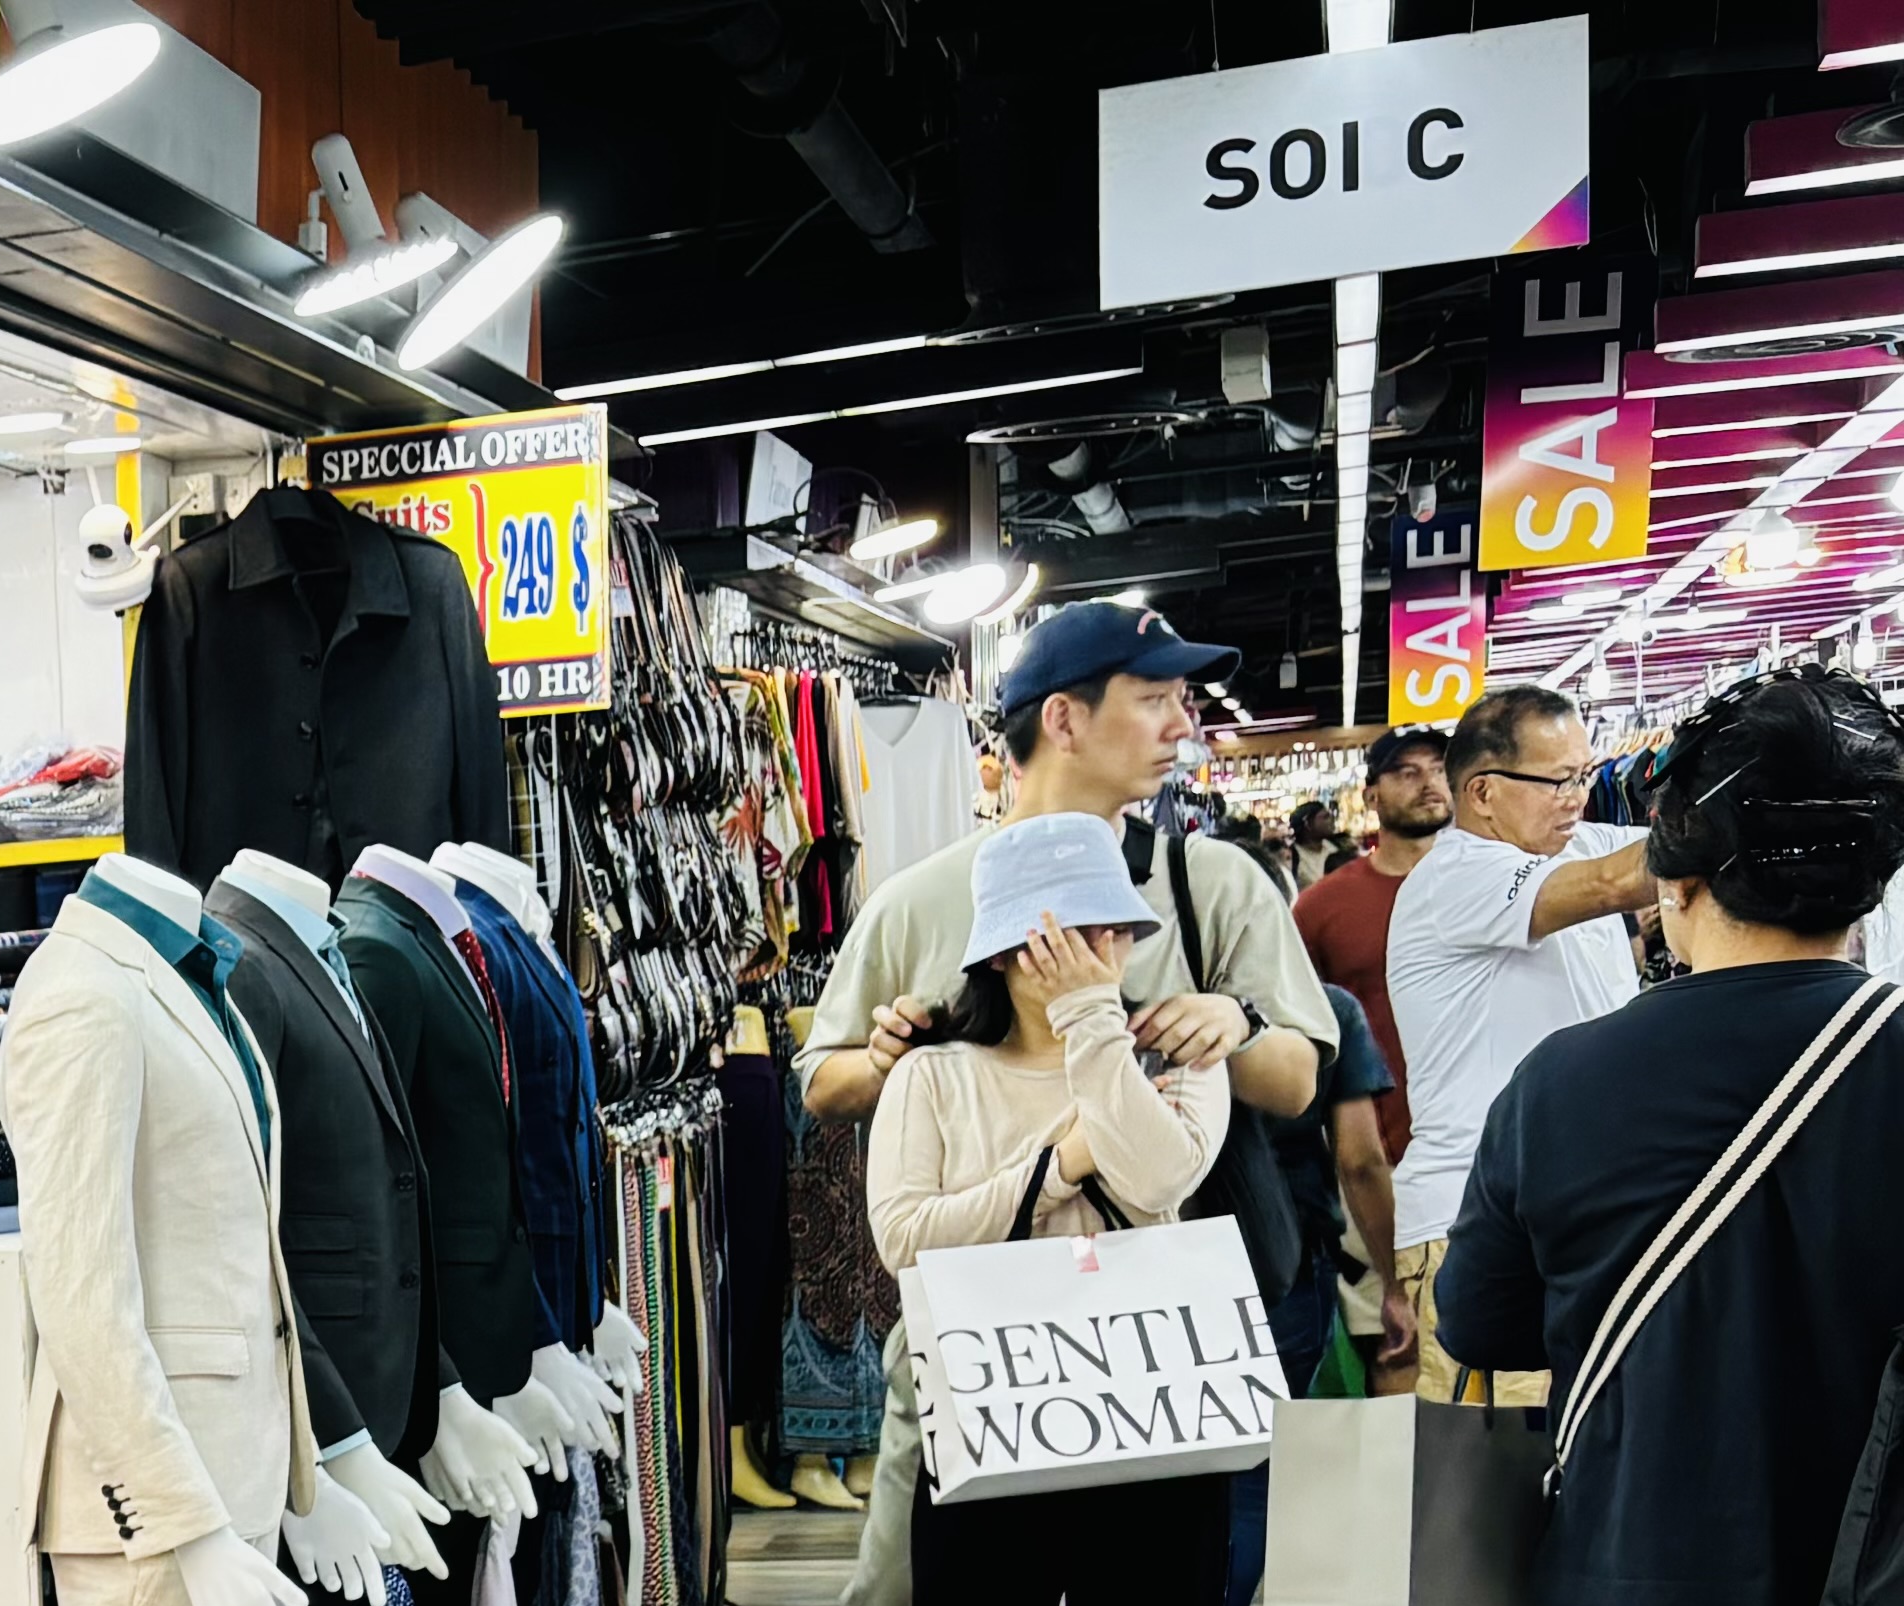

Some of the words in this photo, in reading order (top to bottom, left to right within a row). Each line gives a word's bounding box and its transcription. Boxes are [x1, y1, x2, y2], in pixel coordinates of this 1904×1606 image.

[1202, 121, 1359, 210] SOI
[1406, 108, 1464, 181] C
[322, 436, 476, 484] SPECCIAL
[480, 421, 589, 467] OFFER
[1515, 271, 1623, 550] SALE
[502, 516, 554, 619] 249
[573, 505, 590, 632] $
[1405, 524, 1471, 707] SALE
[497, 665, 530, 702] 10
[538, 662, 591, 699] HR
[937, 1294, 1277, 1394] GENTLE
